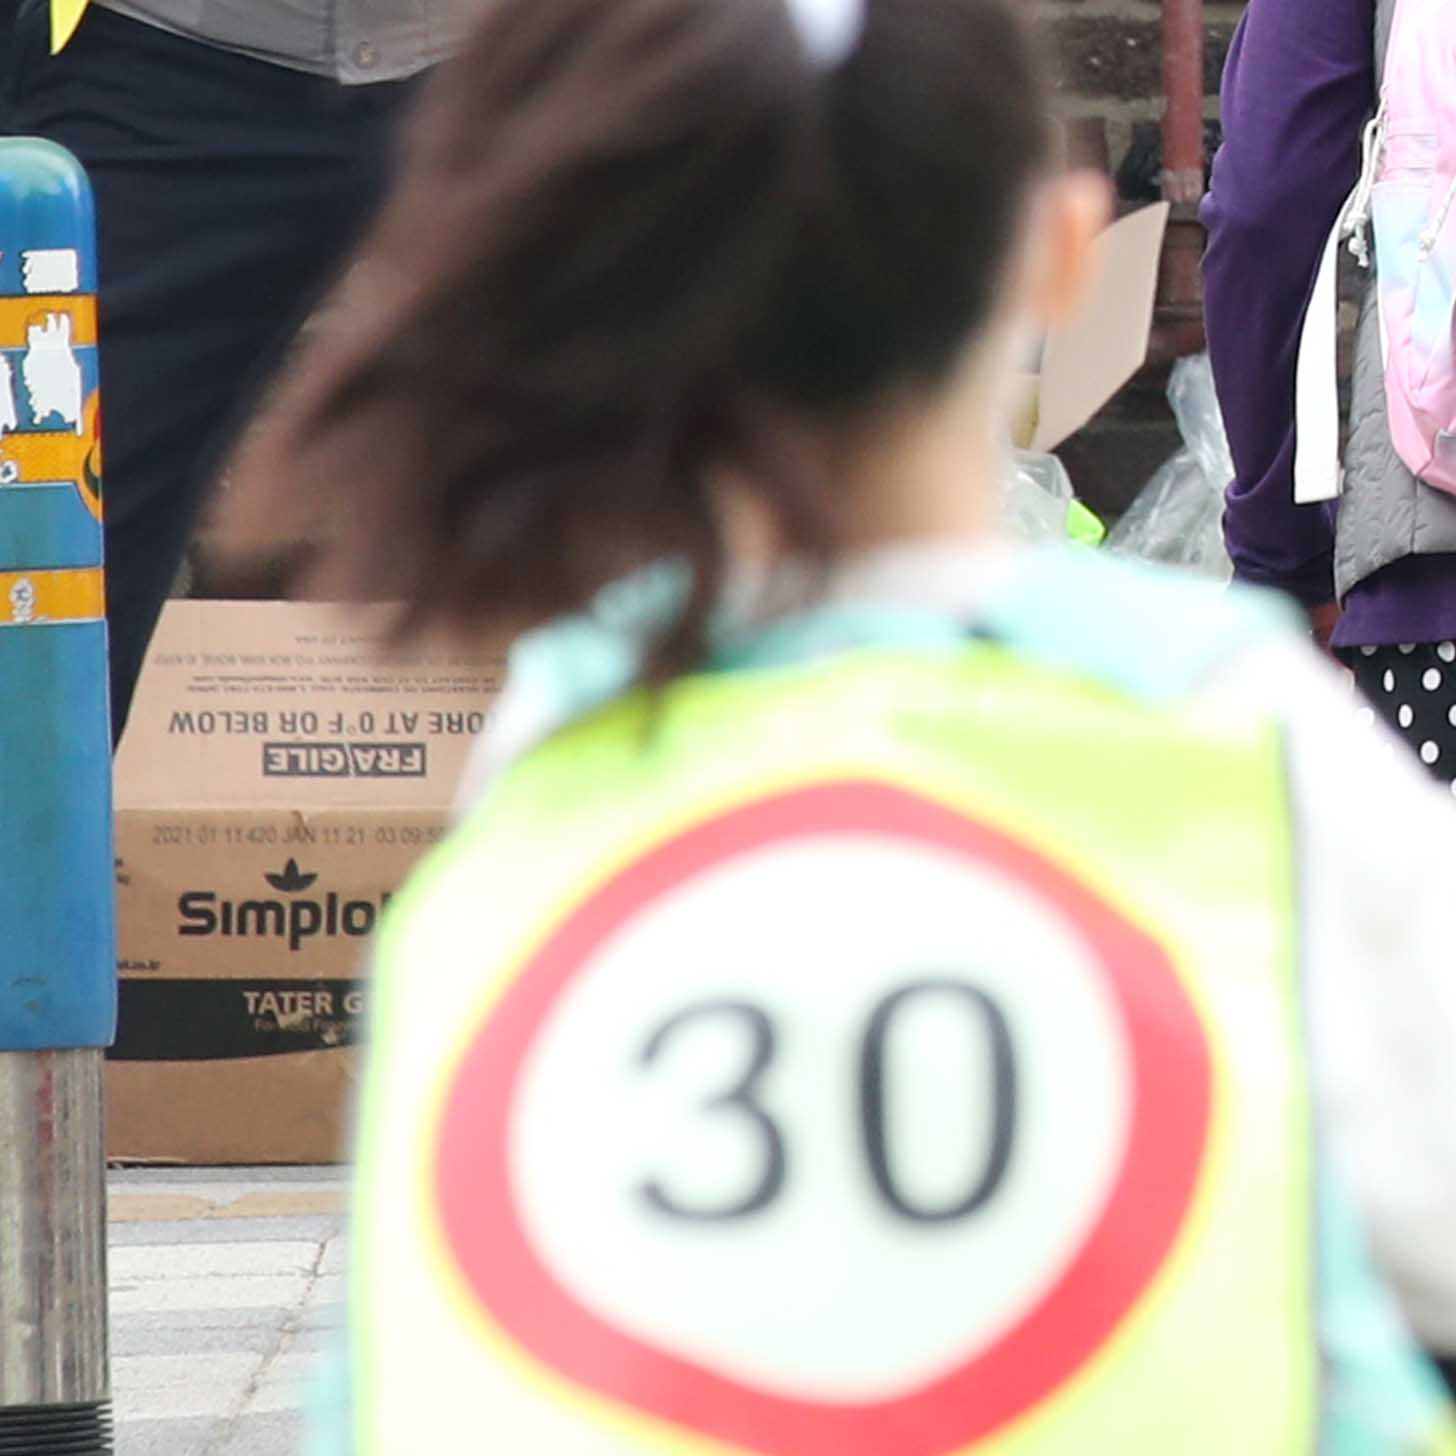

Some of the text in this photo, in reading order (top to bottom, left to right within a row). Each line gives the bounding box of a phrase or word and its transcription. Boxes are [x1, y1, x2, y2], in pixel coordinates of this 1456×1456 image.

[168, 711, 270, 735] BELOW
[279, 712, 319, 735] OR
[385, 712, 419, 735] AT
[428, 712, 488, 735] ORE
[267, 747, 423, 772] FRAGILE
[243, 991, 333, 1015] TATER
[631, 973, 1022, 1231] 30
